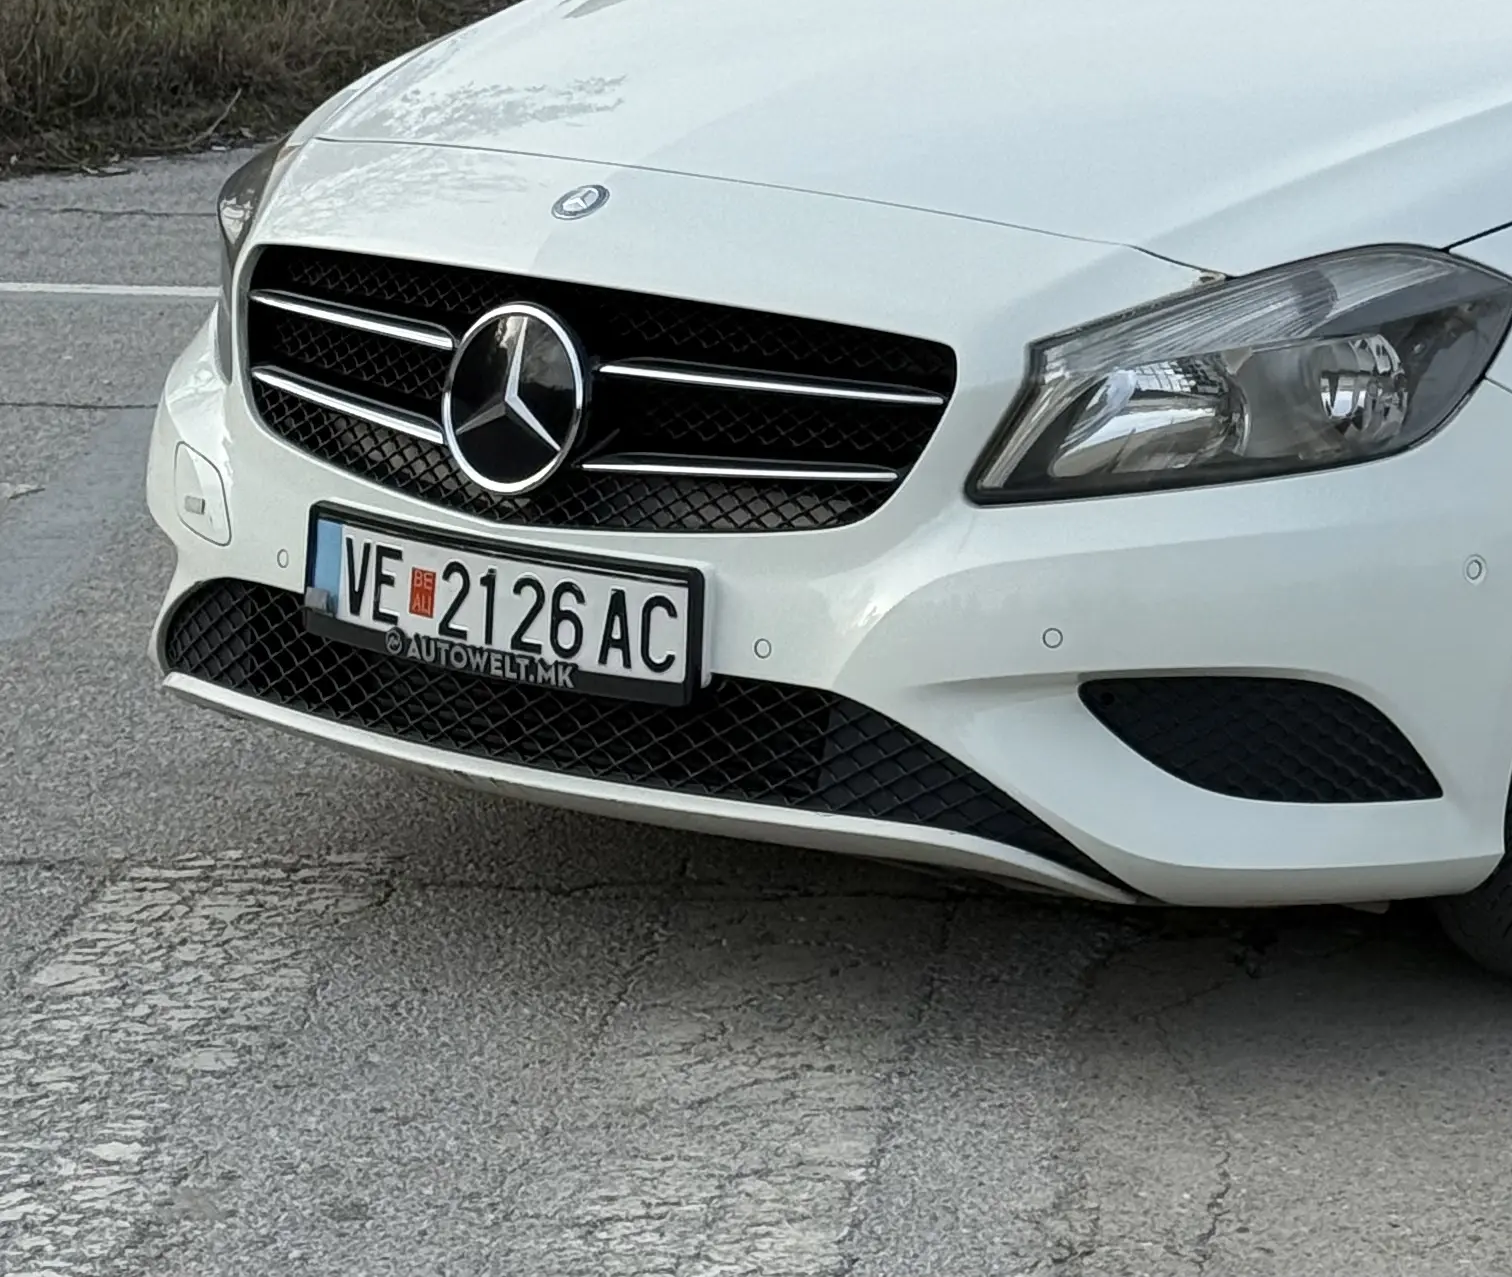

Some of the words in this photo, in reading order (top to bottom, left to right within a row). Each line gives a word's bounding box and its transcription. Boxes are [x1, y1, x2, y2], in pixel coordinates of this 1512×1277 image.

[345, 537, 403, 625] VE
[438, 561, 586, 660] 2126
[598, 588, 678, 674] AC
[406, 637, 576, 689] AUTOWELT.MK
